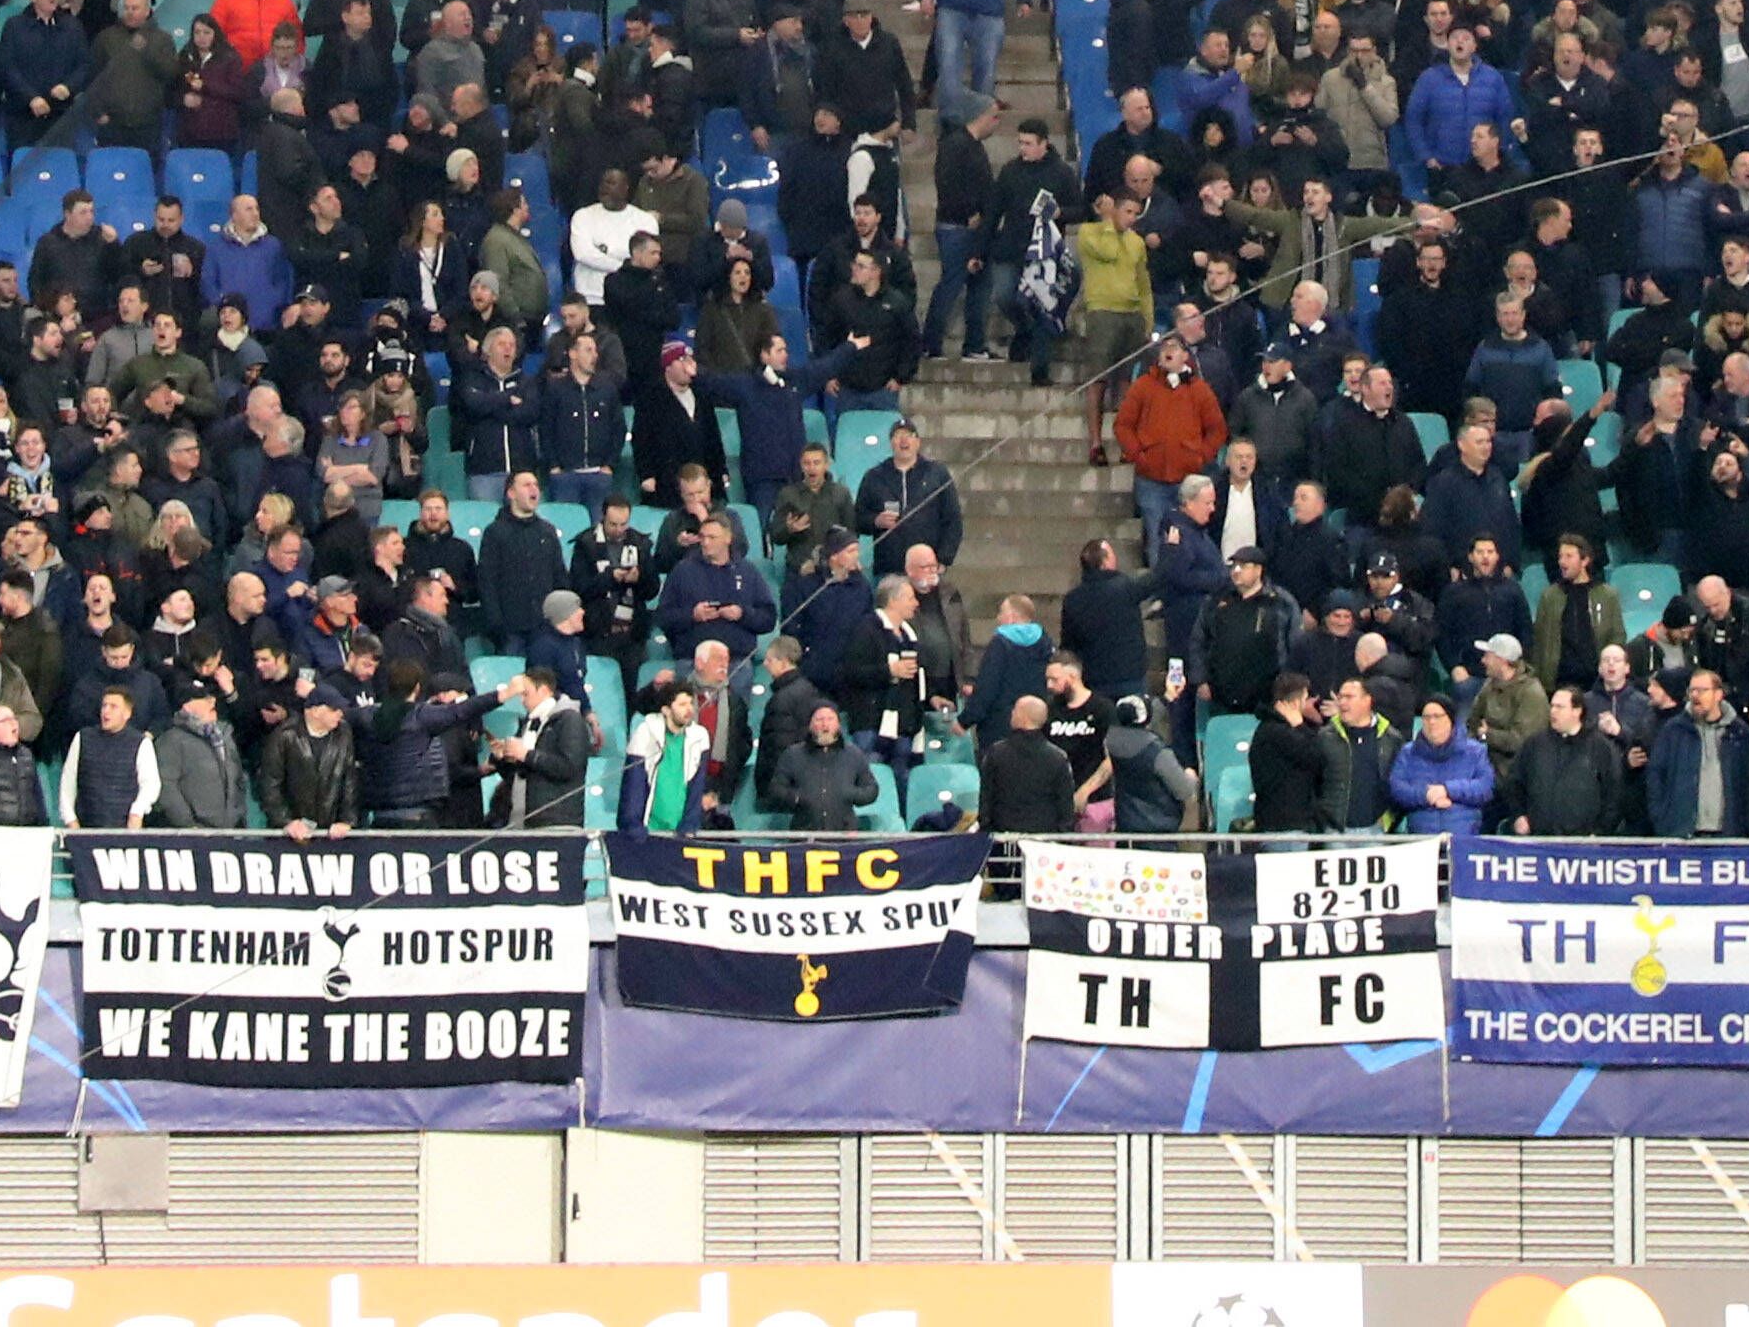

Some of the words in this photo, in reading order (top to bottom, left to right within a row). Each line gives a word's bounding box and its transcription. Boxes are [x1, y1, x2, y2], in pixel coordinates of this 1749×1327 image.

[92, 848, 193, 891] WIN
[219, 850, 355, 896] DRAW
[372, 850, 435, 896] OR
[450, 849, 559, 895] LOSE
[683, 847, 900, 894] THFC
[1314, 856, 1387, 888] EDD
[1469, 855, 1537, 884] THE
[1550, 857, 1702, 886] WHISTLE
[619, 894, 709, 930] WEST
[729, 909, 866, 936] SUSSEX
[883, 898, 963, 930] SPU
[1293, 885, 1401, 919] 82-10
[100, 926, 311, 968] TOTTENHAM
[383, 926, 555, 967] HOTSPUR
[1087, 919, 1223, 959] OTHER
[1252, 919, 1384, 959] PLACE
[1508, 919, 1596, 964] TH
[1079, 973, 1151, 1028] TH
[1319, 972, 1385, 1026] FC
[99, 1008, 170, 1059] WE
[187, 1010, 311, 1063] KANE
[324, 1012, 413, 1061] THE
[425, 1010, 572, 1060] BOOZE
[1464, 1011, 1529, 1042] THE
[1535, 1012, 1713, 1045] COCKEREL
